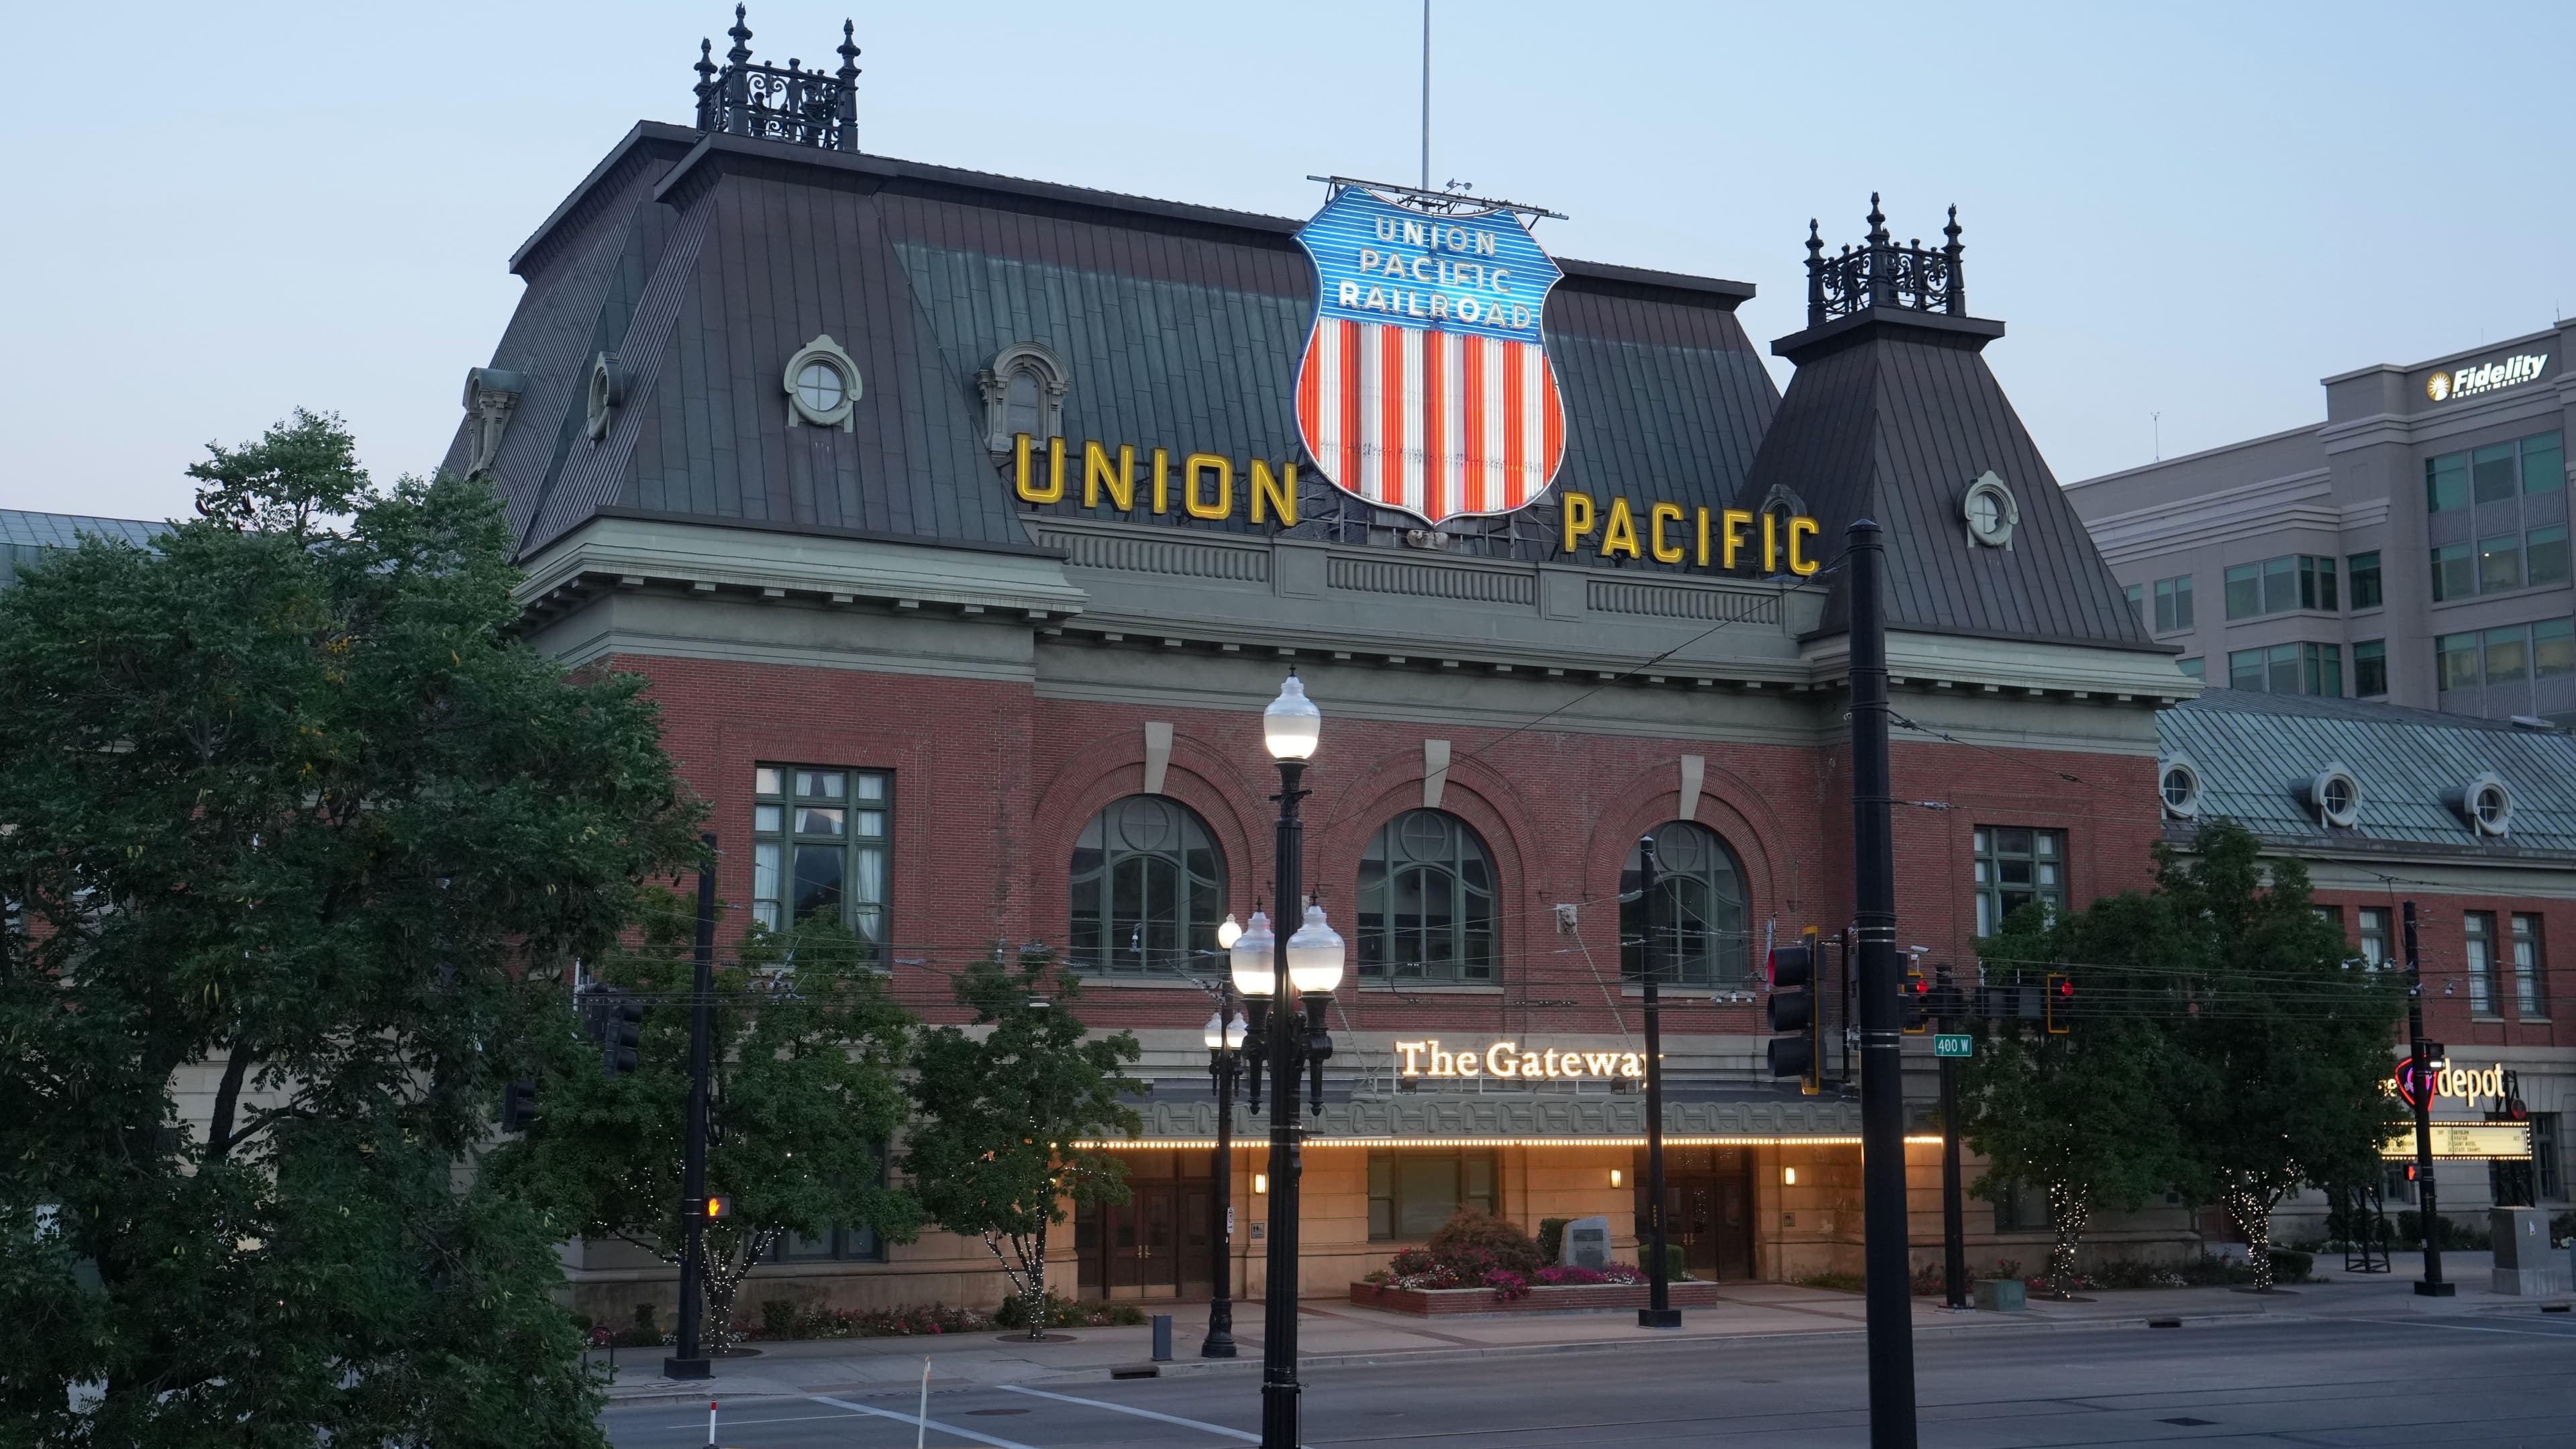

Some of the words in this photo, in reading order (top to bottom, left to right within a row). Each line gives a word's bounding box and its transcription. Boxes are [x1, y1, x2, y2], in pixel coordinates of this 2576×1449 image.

[1376, 215, 1495, 257] UNION
[1360, 247, 1511, 293] PACIFIC
[1339, 280, 1531, 329] RAILROAD
[2453, 354, 2548, 393] Fidelity
[1013, 432, 1297, 527] UNION
[1560, 491, 1820, 577] PACIFIC
[1396, 1040, 1478, 1077] The
[1486, 1042, 1664, 1088] Gatewa
[1938, 1039, 1957, 1052] 400
[1961, 1039, 1968, 1052] W
[2438, 1058, 2506, 1107] depot
